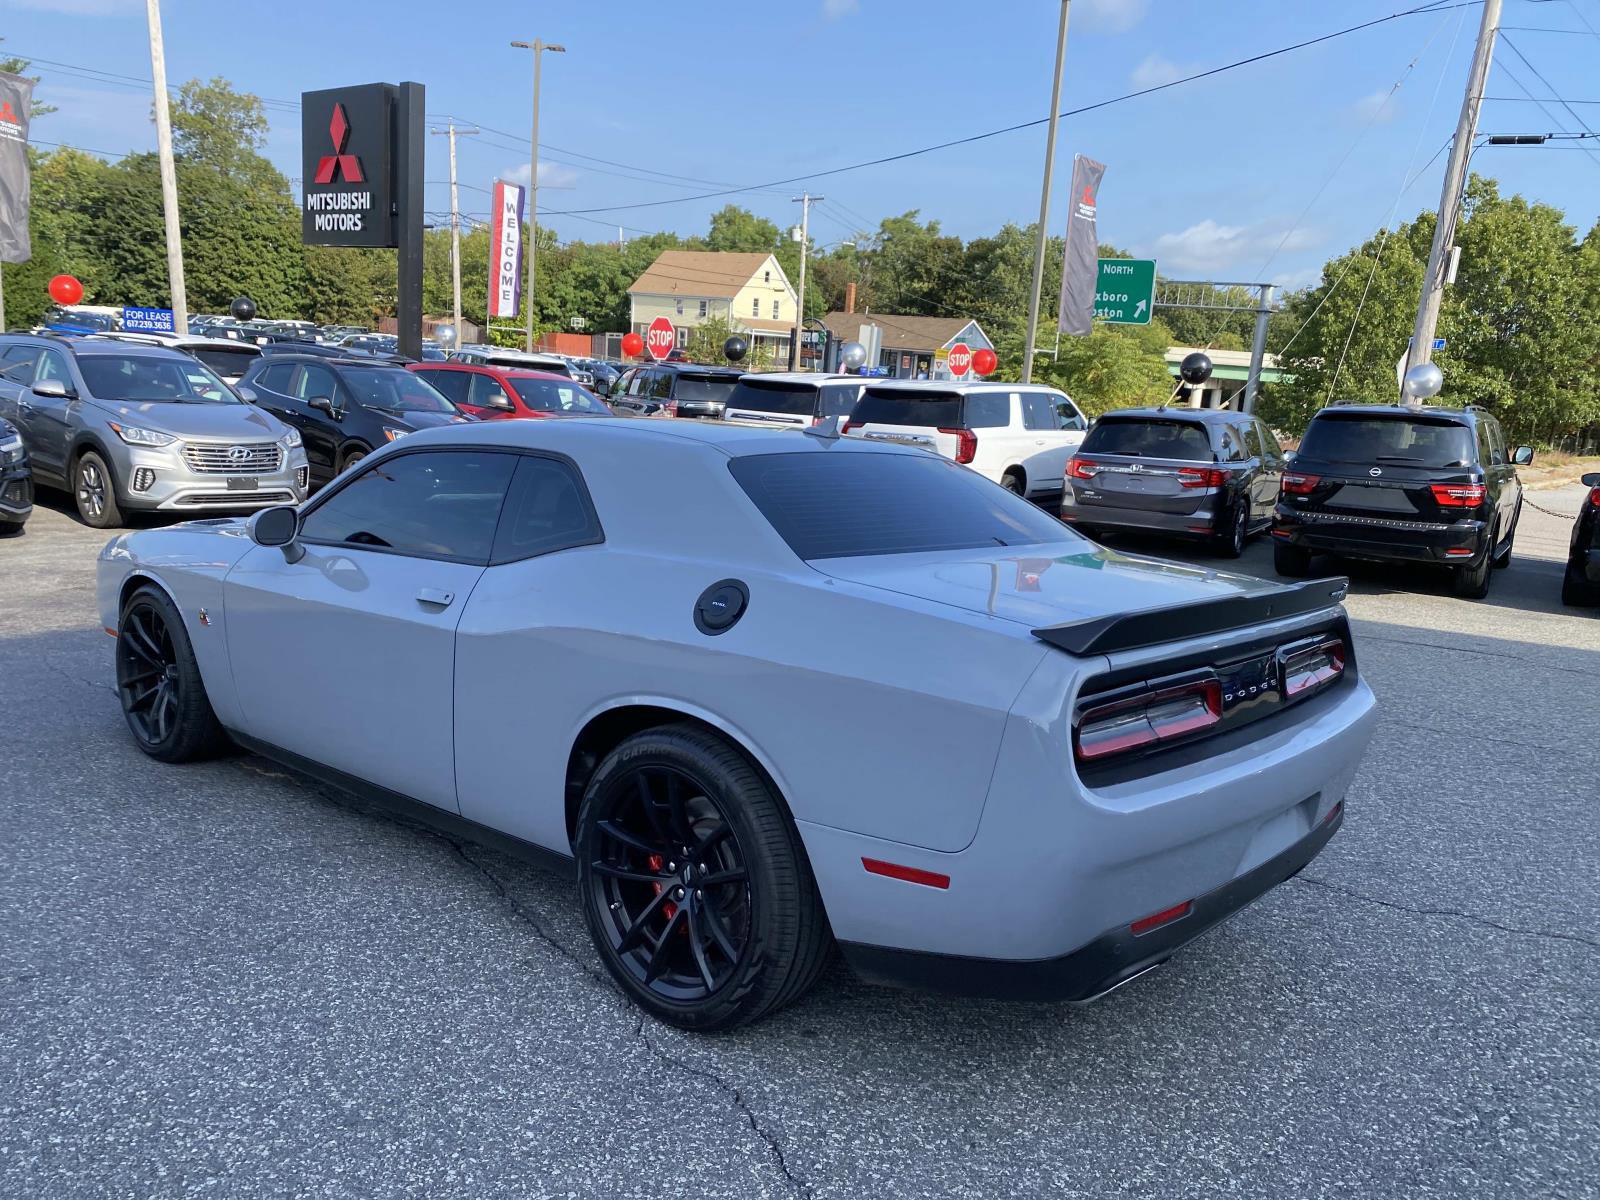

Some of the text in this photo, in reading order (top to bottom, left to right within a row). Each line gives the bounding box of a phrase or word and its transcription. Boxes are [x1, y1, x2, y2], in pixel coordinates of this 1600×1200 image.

[307, 191, 370, 211] MITSUBISHI
[315, 213, 362, 231] MOTORS
[502, 202, 516, 301] WELCOME
[1095, 291, 1128, 302] xboro
[125, 310, 172, 322] FOR LEASE
[1092, 307, 1123, 318] oston
[126, 320, 172, 330] 617.239.3636
[650, 329, 673, 346] STOP
[950, 353, 970, 366] STOP
[1224, 679, 1277, 701] DODGE
